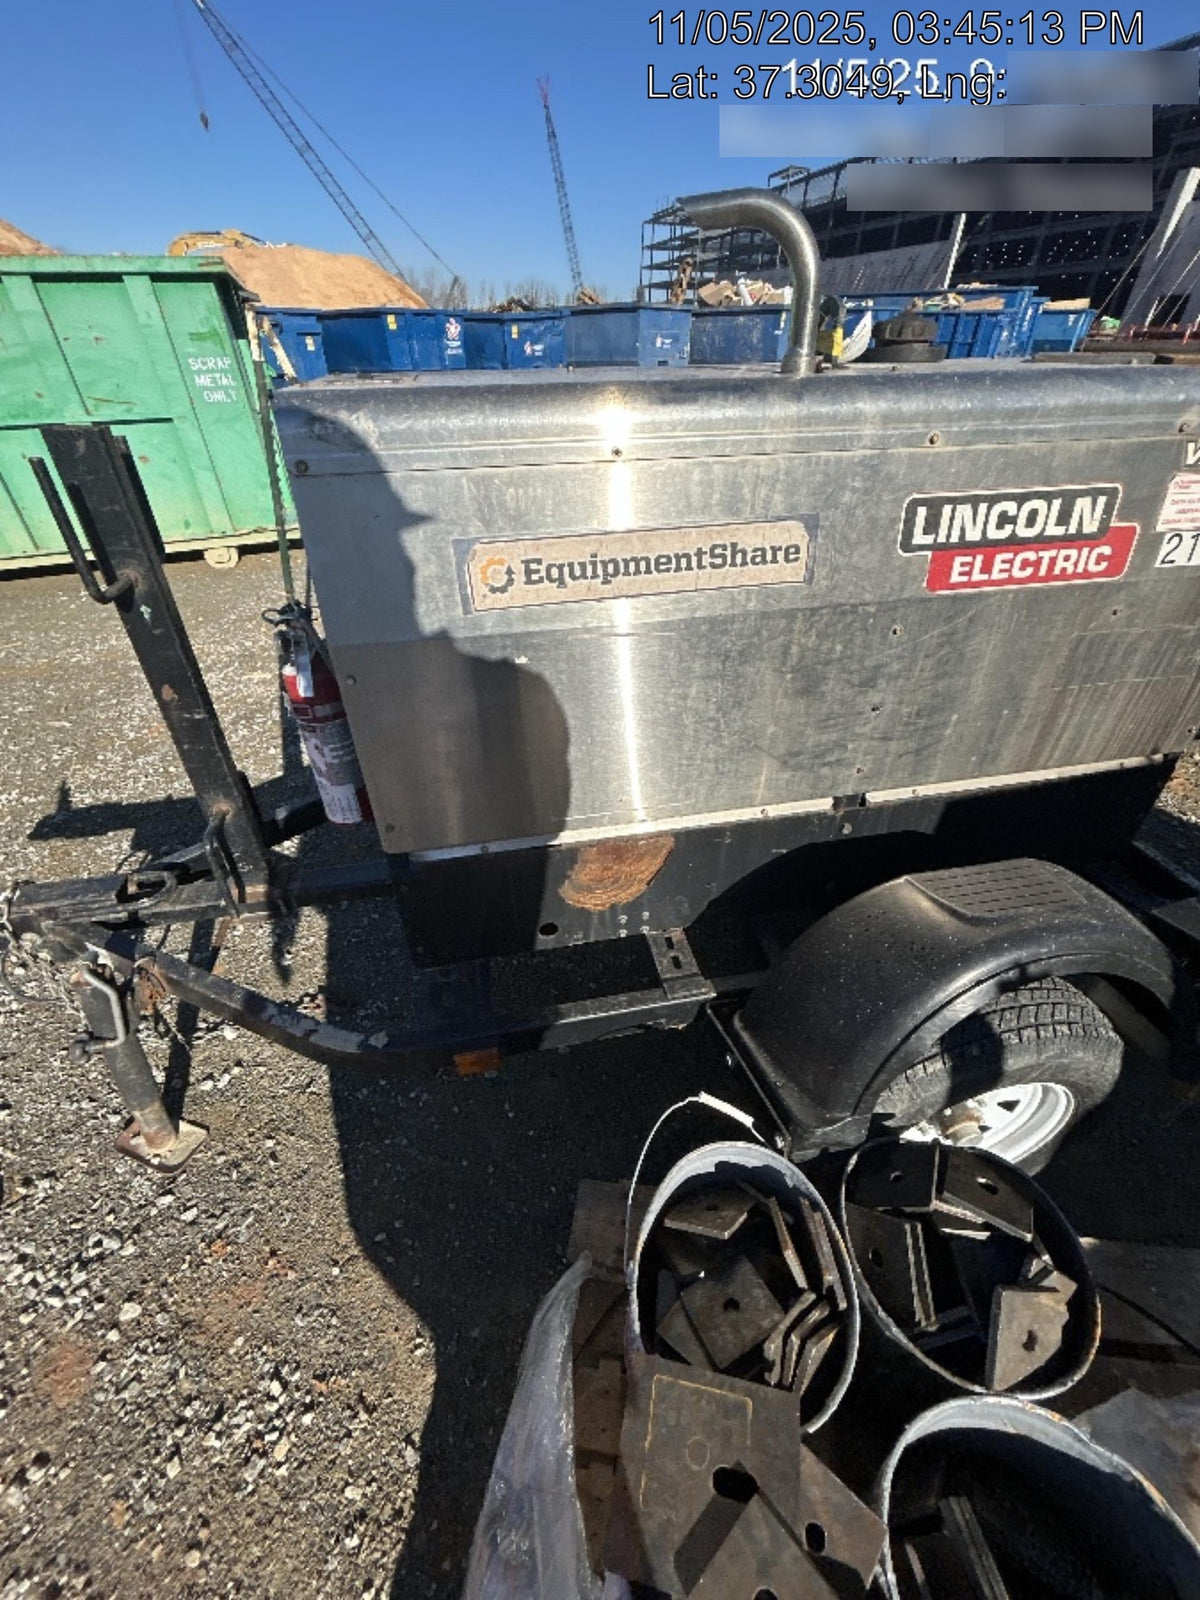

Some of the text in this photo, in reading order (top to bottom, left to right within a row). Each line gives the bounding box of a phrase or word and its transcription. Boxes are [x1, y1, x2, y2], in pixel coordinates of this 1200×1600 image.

[194, 372, 237, 388] METAL
[203, 389, 238, 403] ONLY
[911, 495, 1108, 546] LINCOLN
[520, 541, 802, 590] EquipmentShare
[949, 545, 1113, 584] ELECTRIC
